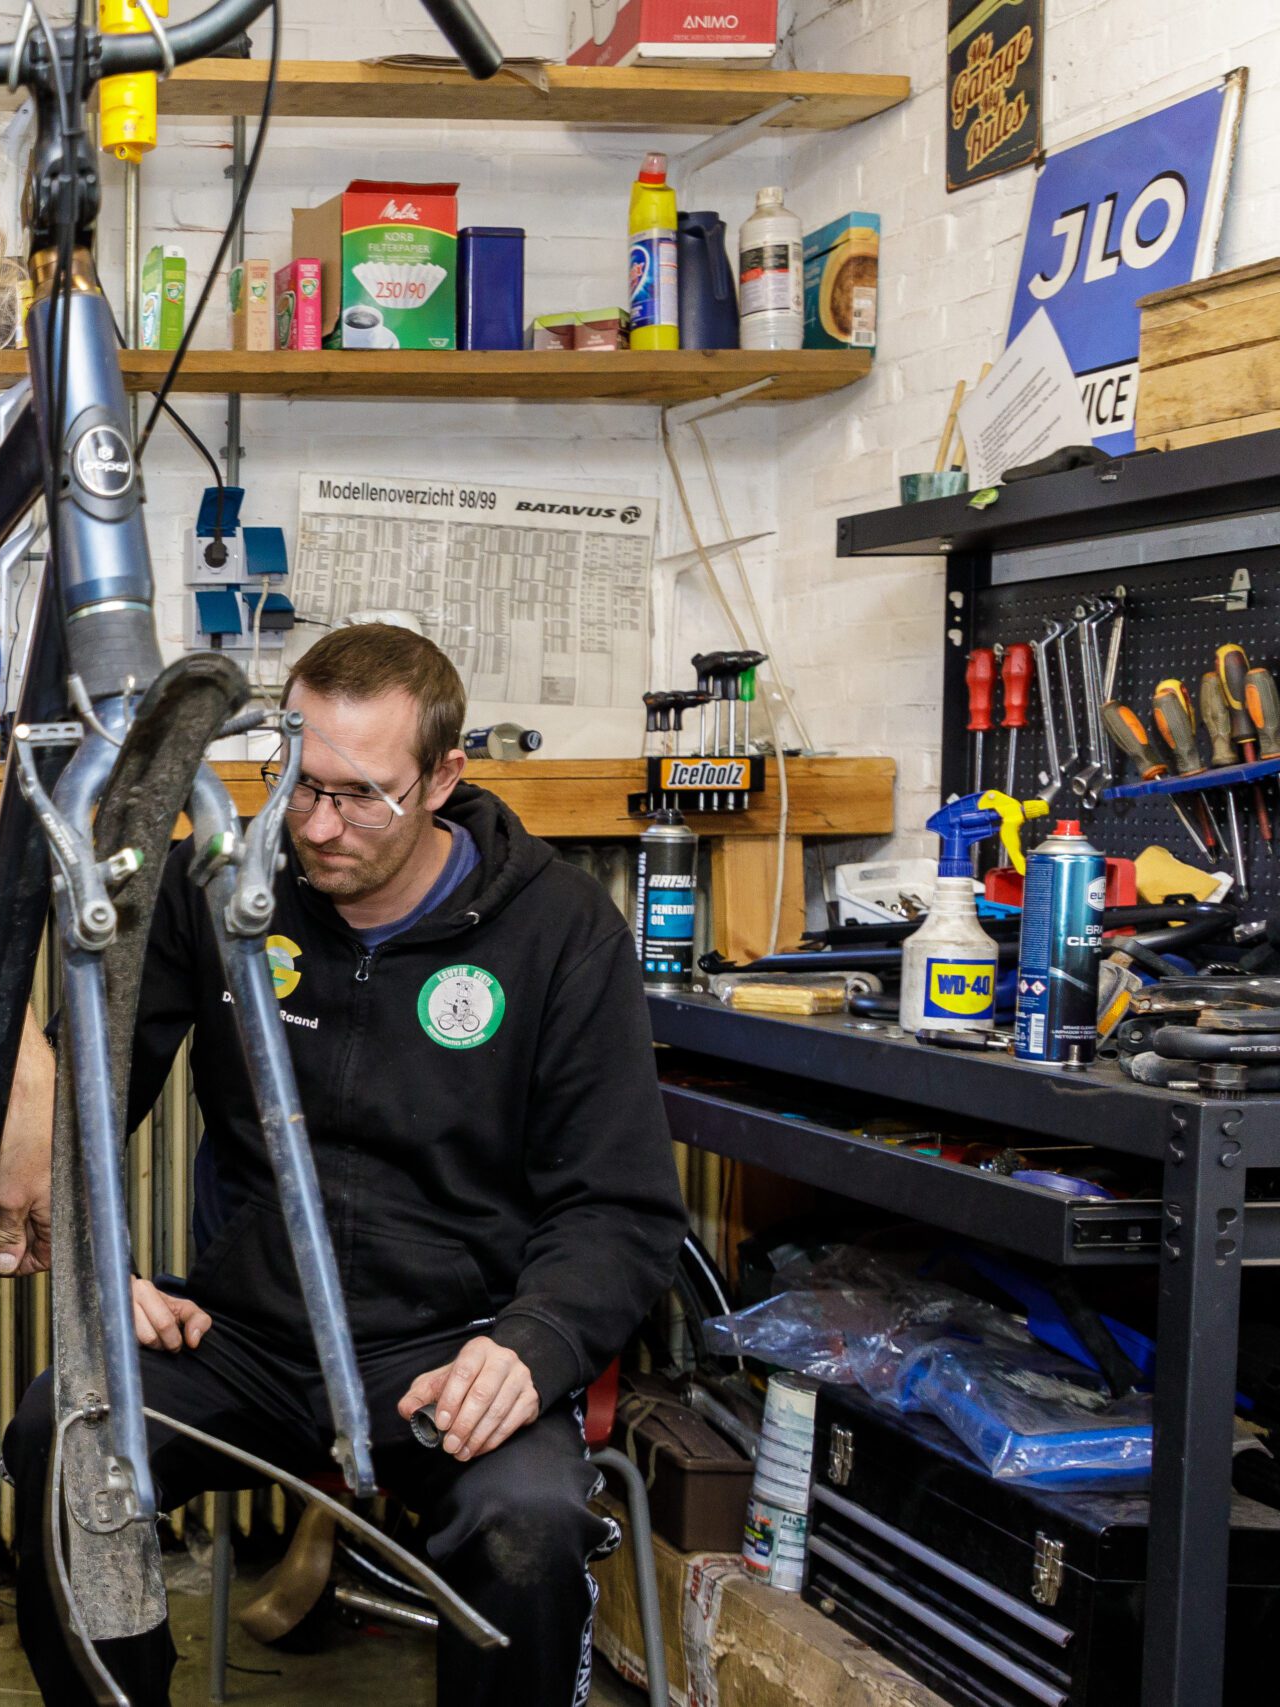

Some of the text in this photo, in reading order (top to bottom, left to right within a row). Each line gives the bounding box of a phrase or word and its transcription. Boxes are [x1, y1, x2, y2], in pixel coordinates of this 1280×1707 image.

[683, 15, 739, 28] ANIMO
[967, 32, 993, 66] My
[952, 26, 1033, 129] Garage
[980, 86, 1006, 118] My
[966, 90, 1030, 171] Rules
[384, 232, 414, 242] KORB
[1028, 171, 1188, 300] JLO
[376, 282, 426, 299] 250/90
[319, 480, 497, 510] Modellenoverzicht 98/99
[515, 501, 617, 518] BATAVUS
[668, 762, 744, 786] IceToolz
[651, 915, 665, 926] OIL
[937, 974, 990, 995] WD-40
[280, 1009, 318, 1029] Raand
